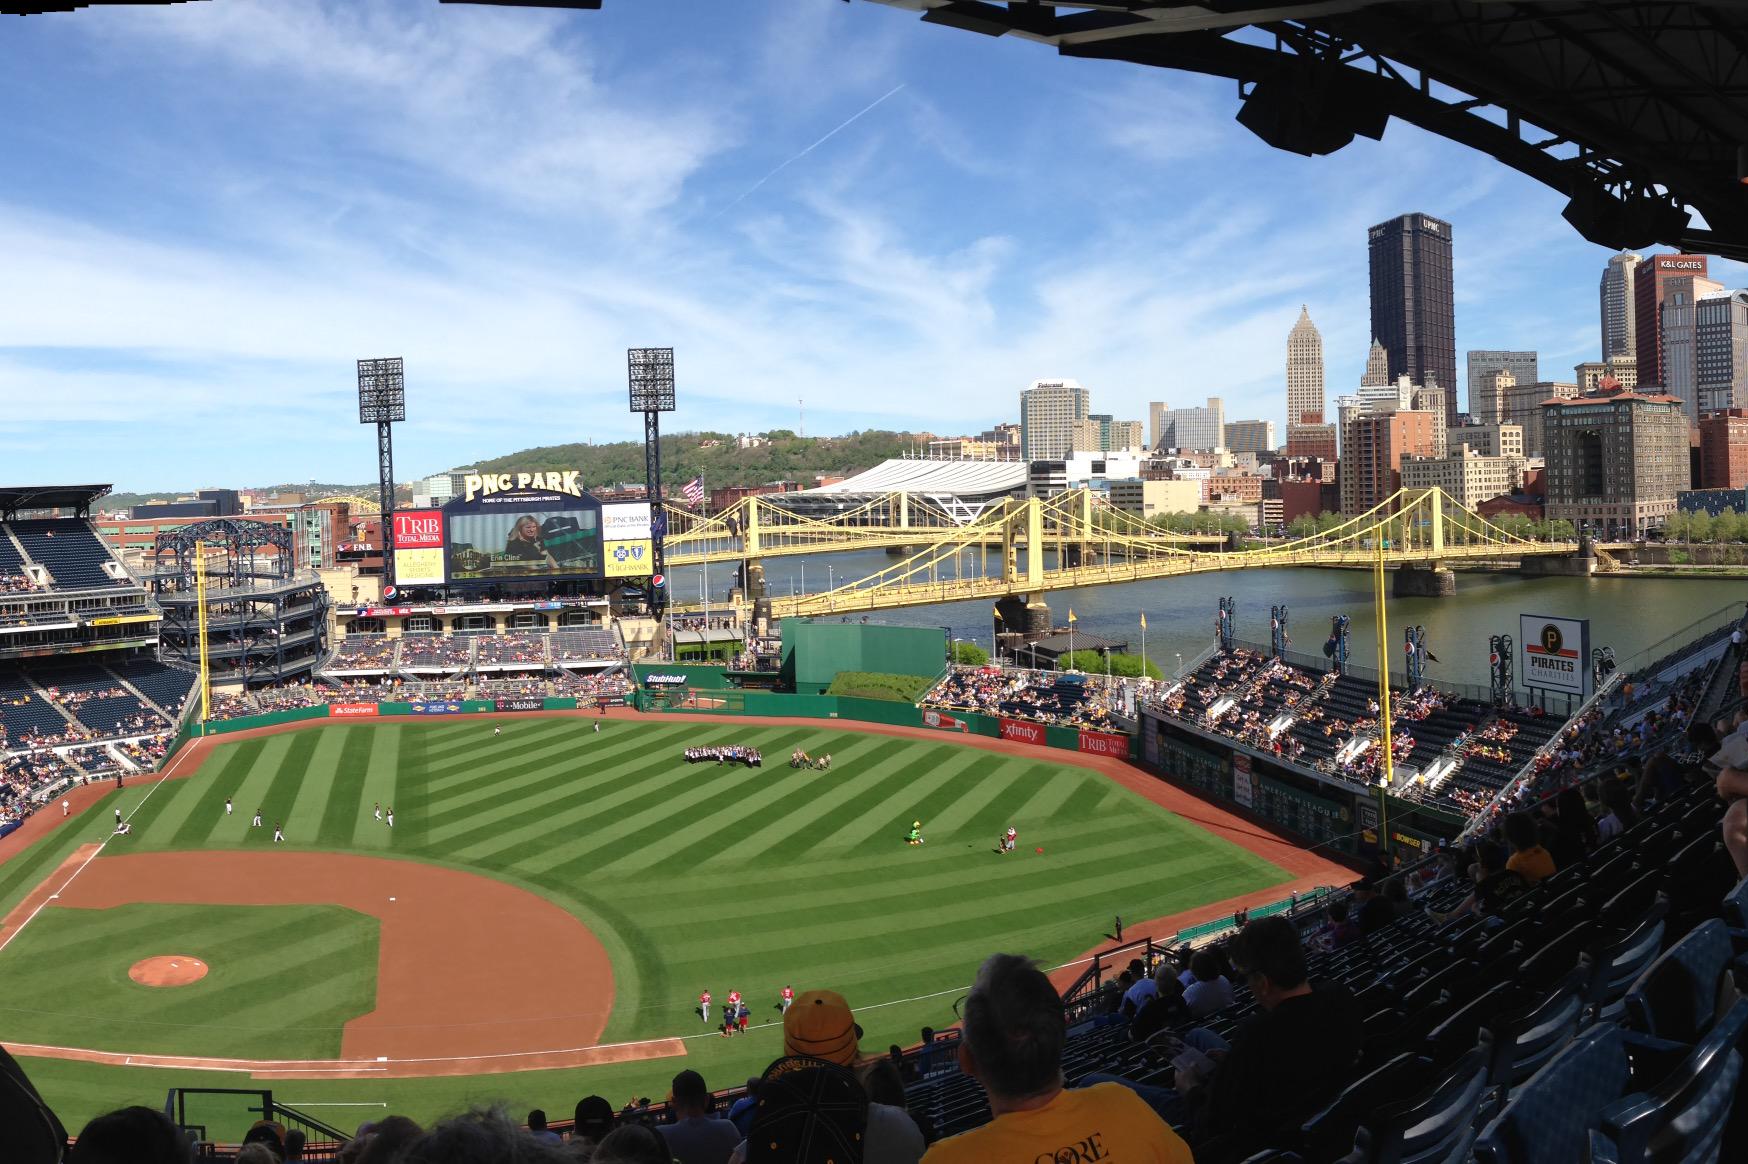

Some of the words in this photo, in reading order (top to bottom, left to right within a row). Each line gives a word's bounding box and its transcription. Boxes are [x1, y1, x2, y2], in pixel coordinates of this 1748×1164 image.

[1423, 219, 1440, 233] UPMC
[1661, 261, 1675, 269] K&L
[1676, 261, 1702, 269] GATES
[464, 473, 513, 502] PNC
[517, 470, 582, 498] PARK
[396, 516, 440, 534] TRIB
[397, 534, 418, 544] TOTAL
[419, 533, 440, 543] MEDIA
[490, 554, 501, 562] Erin
[503, 553, 521, 561] Cline
[1531, 656, 1574, 673] PIRATES
[646, 674, 686, 683] StubHub!
[1531, 668, 1575, 681] CHARITIES
[1006, 723, 1038, 741] xfinity
[1079, 734, 1106, 752] TRIB
[1259, 783, 1301, 804] AMERICAN
[1396, 832, 1421, 848] BOWSER
